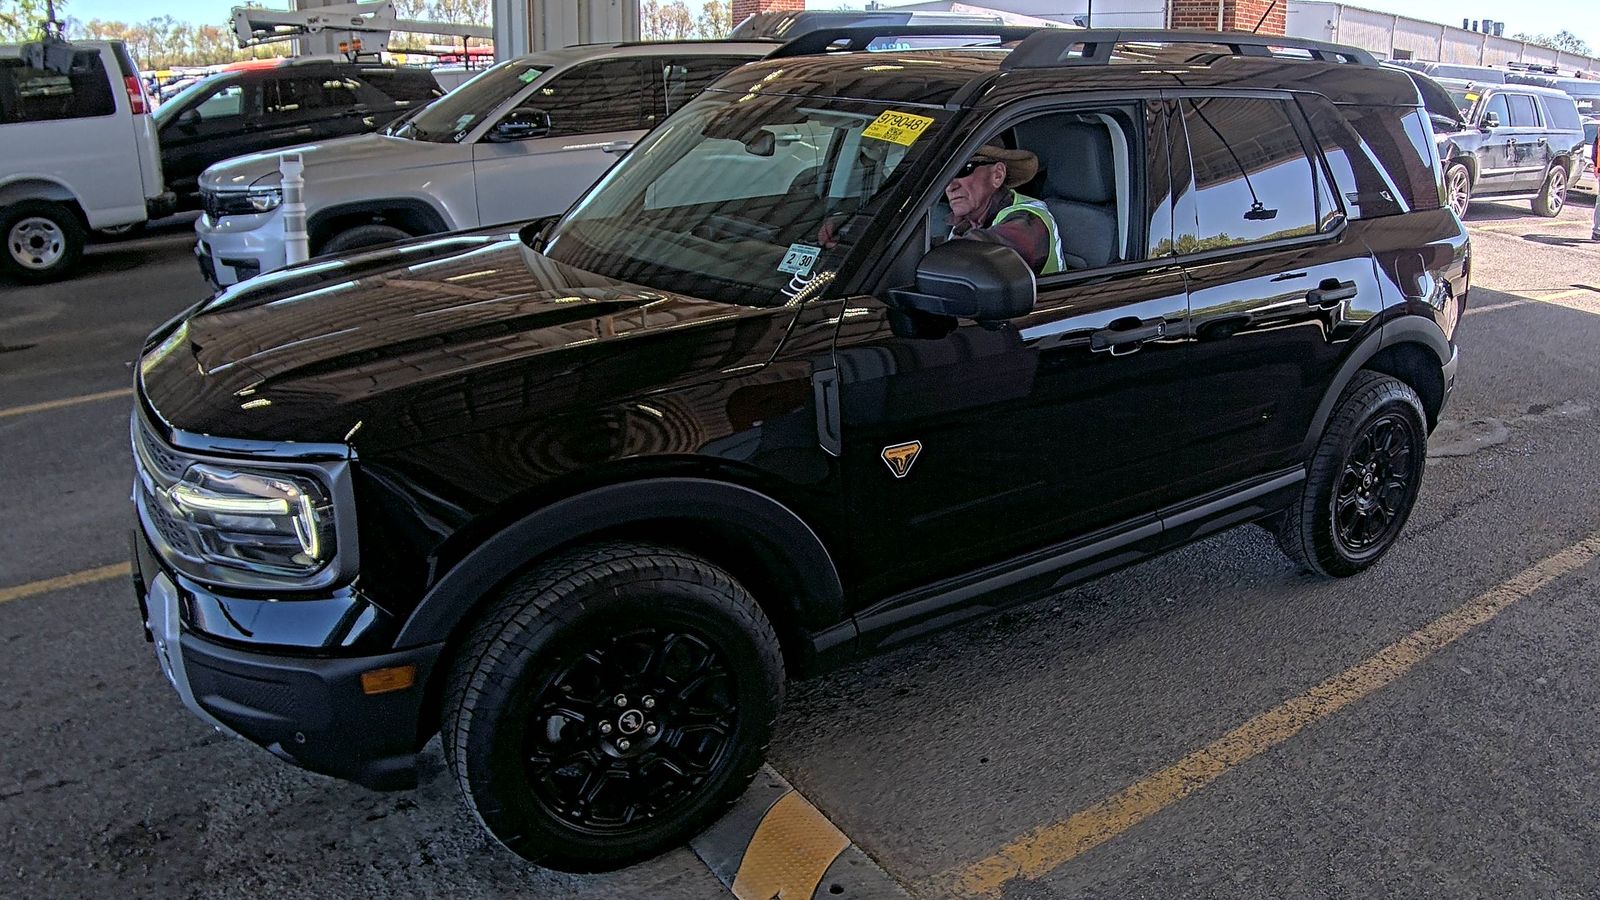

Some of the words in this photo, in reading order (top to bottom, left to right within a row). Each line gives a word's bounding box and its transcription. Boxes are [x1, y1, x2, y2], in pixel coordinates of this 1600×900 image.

[877, 113, 930, 131] 9790481
[786, 253, 796, 264] 2
[799, 255, 812, 267] 30
